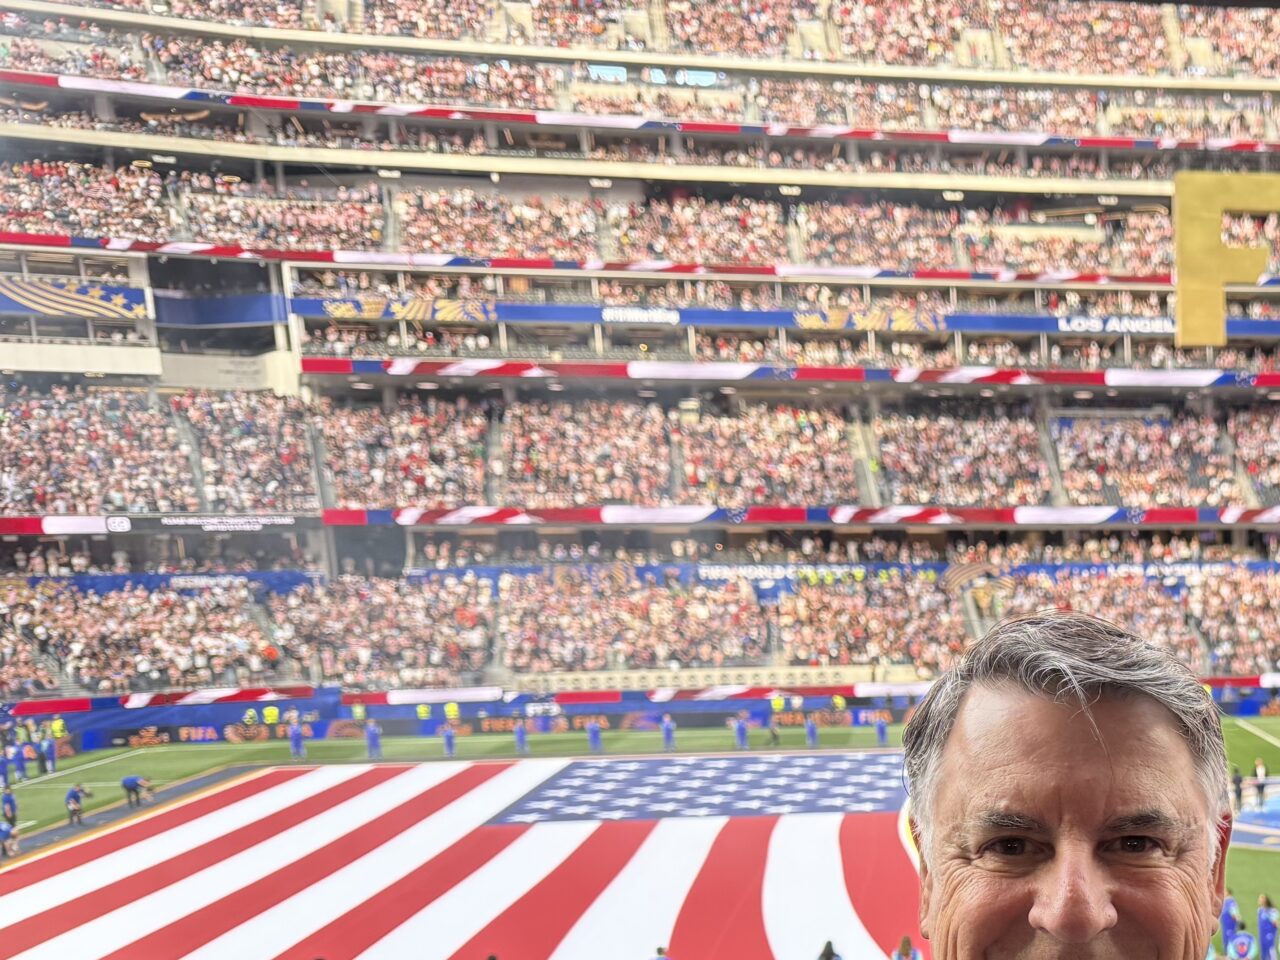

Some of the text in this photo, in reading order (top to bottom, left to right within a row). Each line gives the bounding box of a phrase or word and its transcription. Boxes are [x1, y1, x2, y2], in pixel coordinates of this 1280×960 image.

[1058, 316, 1177, 333] LOS ANGEL
[178, 727, 219, 742] FIFA
[275, 724, 313, 739] FA
